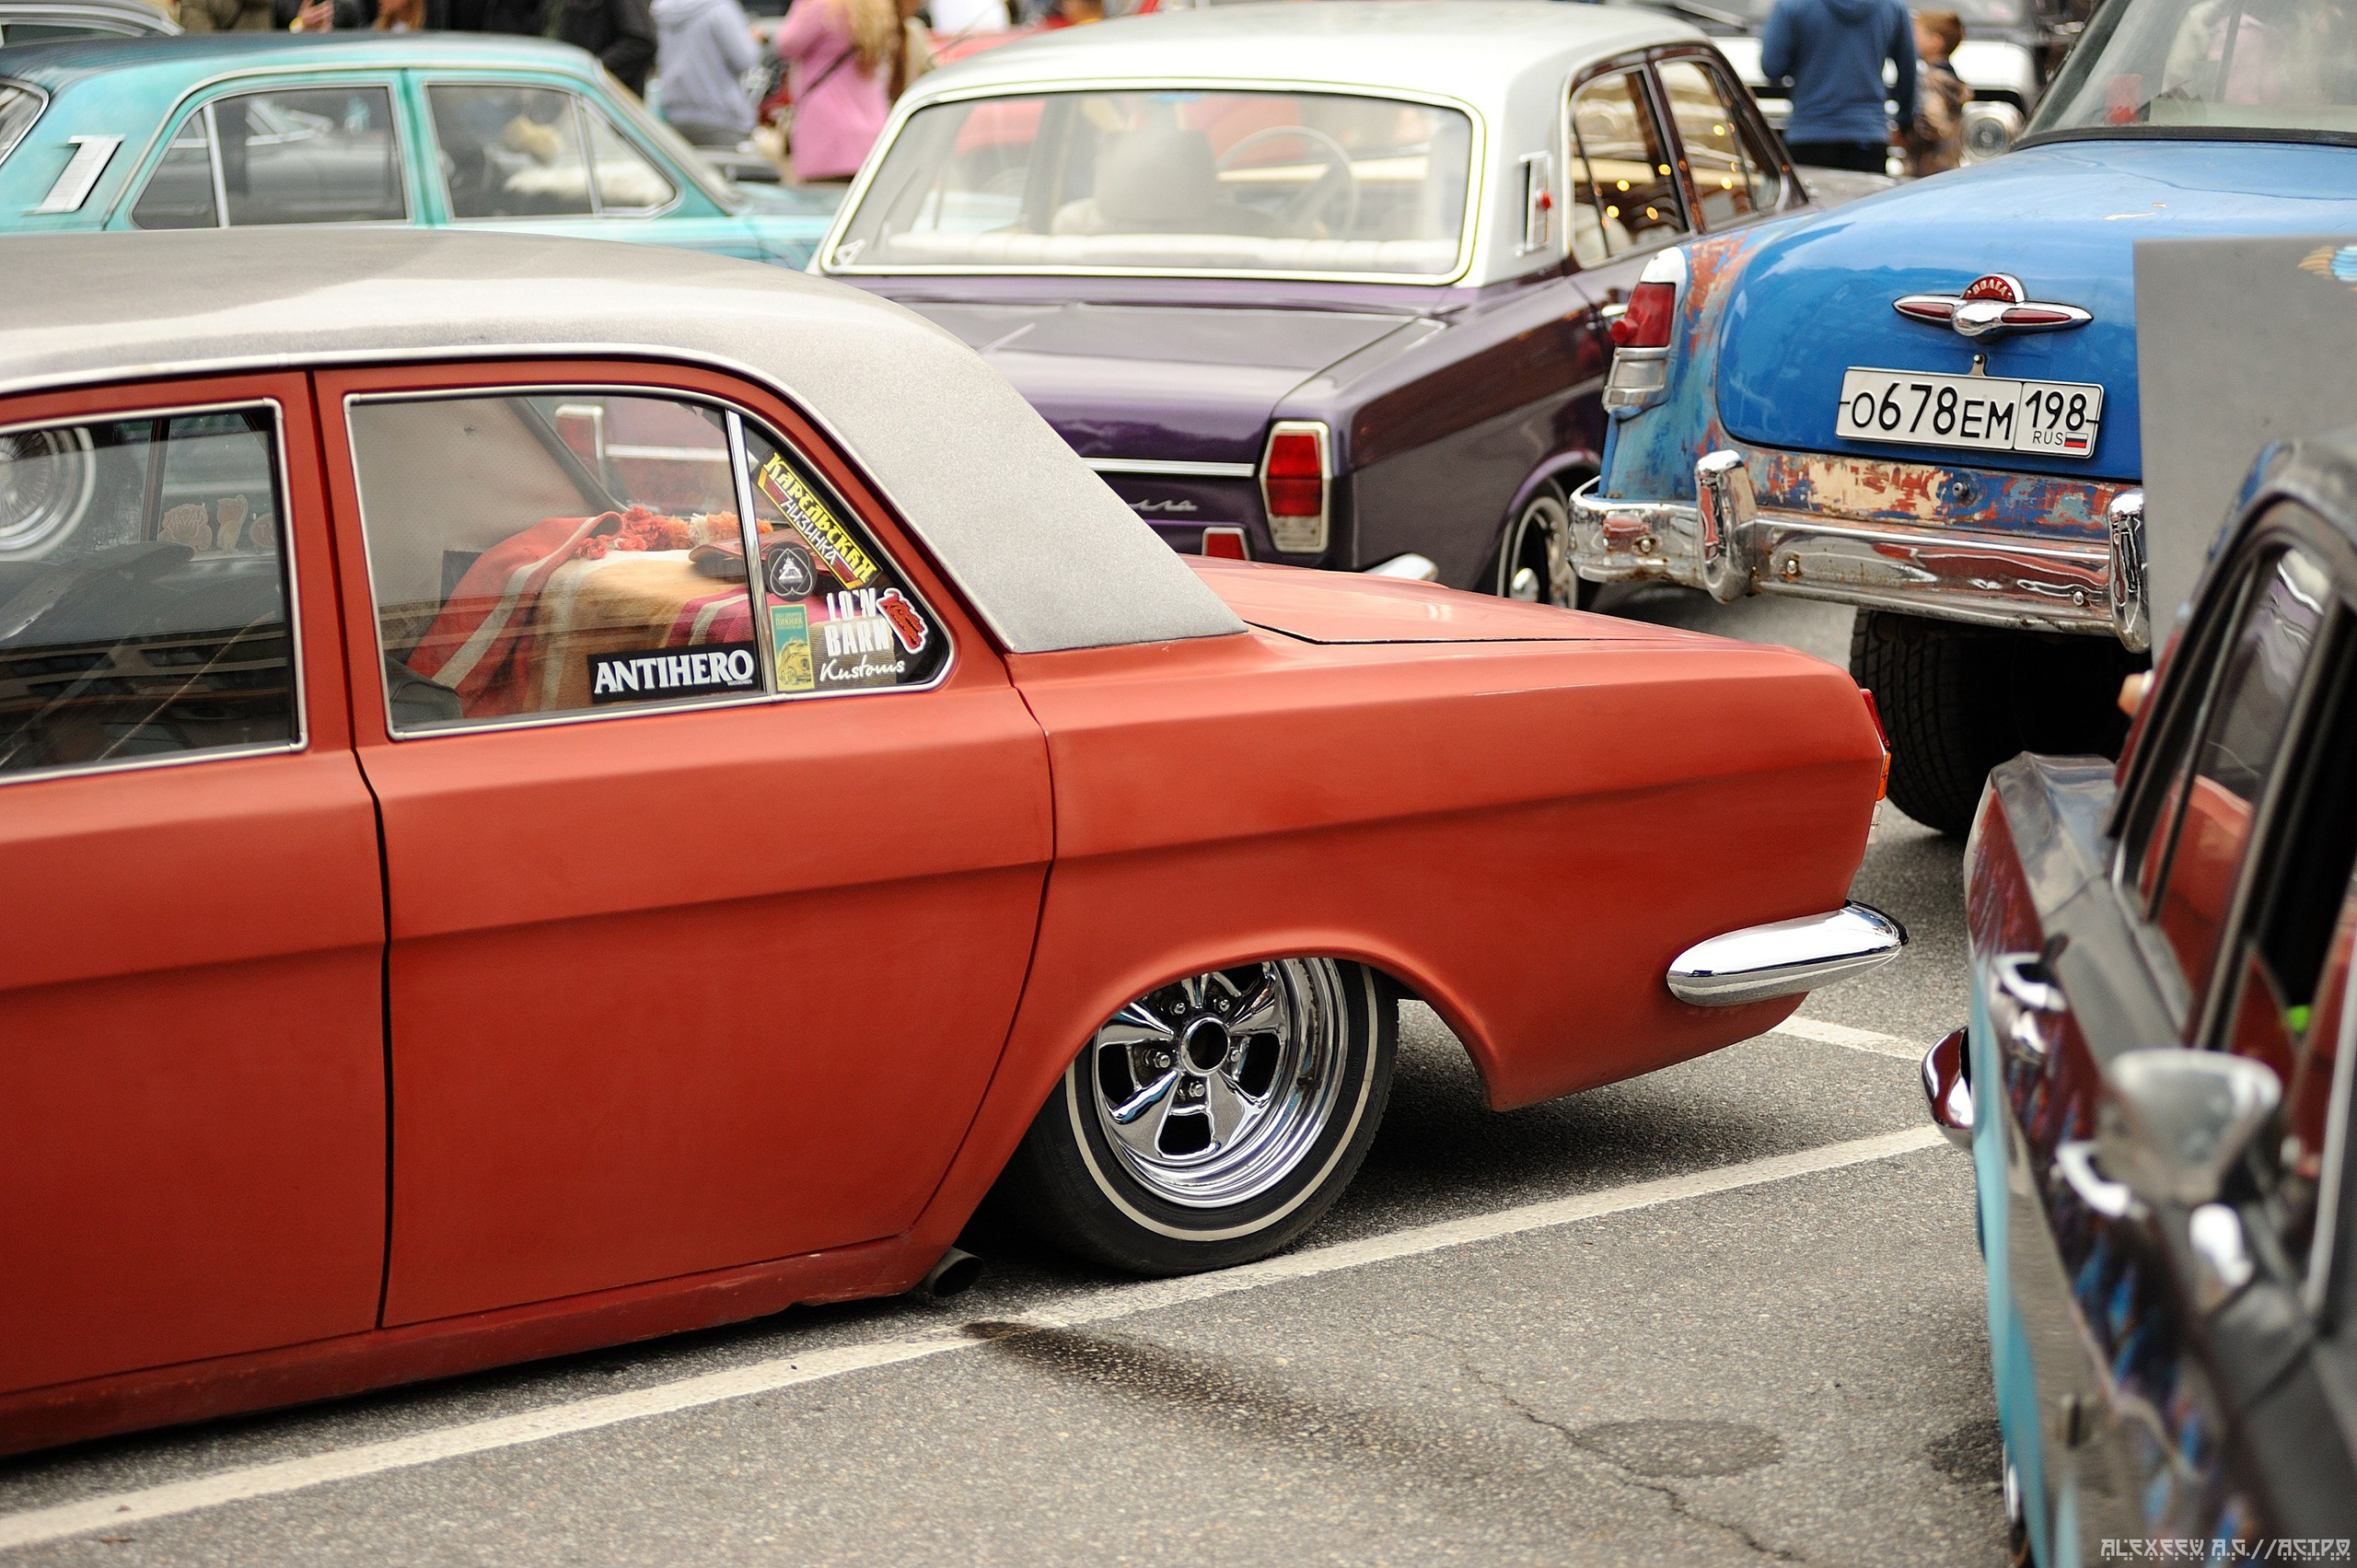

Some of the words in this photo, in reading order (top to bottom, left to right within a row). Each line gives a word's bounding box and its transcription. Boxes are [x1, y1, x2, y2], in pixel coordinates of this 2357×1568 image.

[1972, 279, 2008, 296] ВОЛГА
[2026, 389, 2087, 430] 198
[2032, 430, 2063, 446] RUS
[763, 452, 877, 584] КАРЕЛЬСКАЯ
[824, 618, 890, 656] BARN
[594, 649, 754, 694] ANTIHERO
[819, 654, 905, 681] Kustoms
